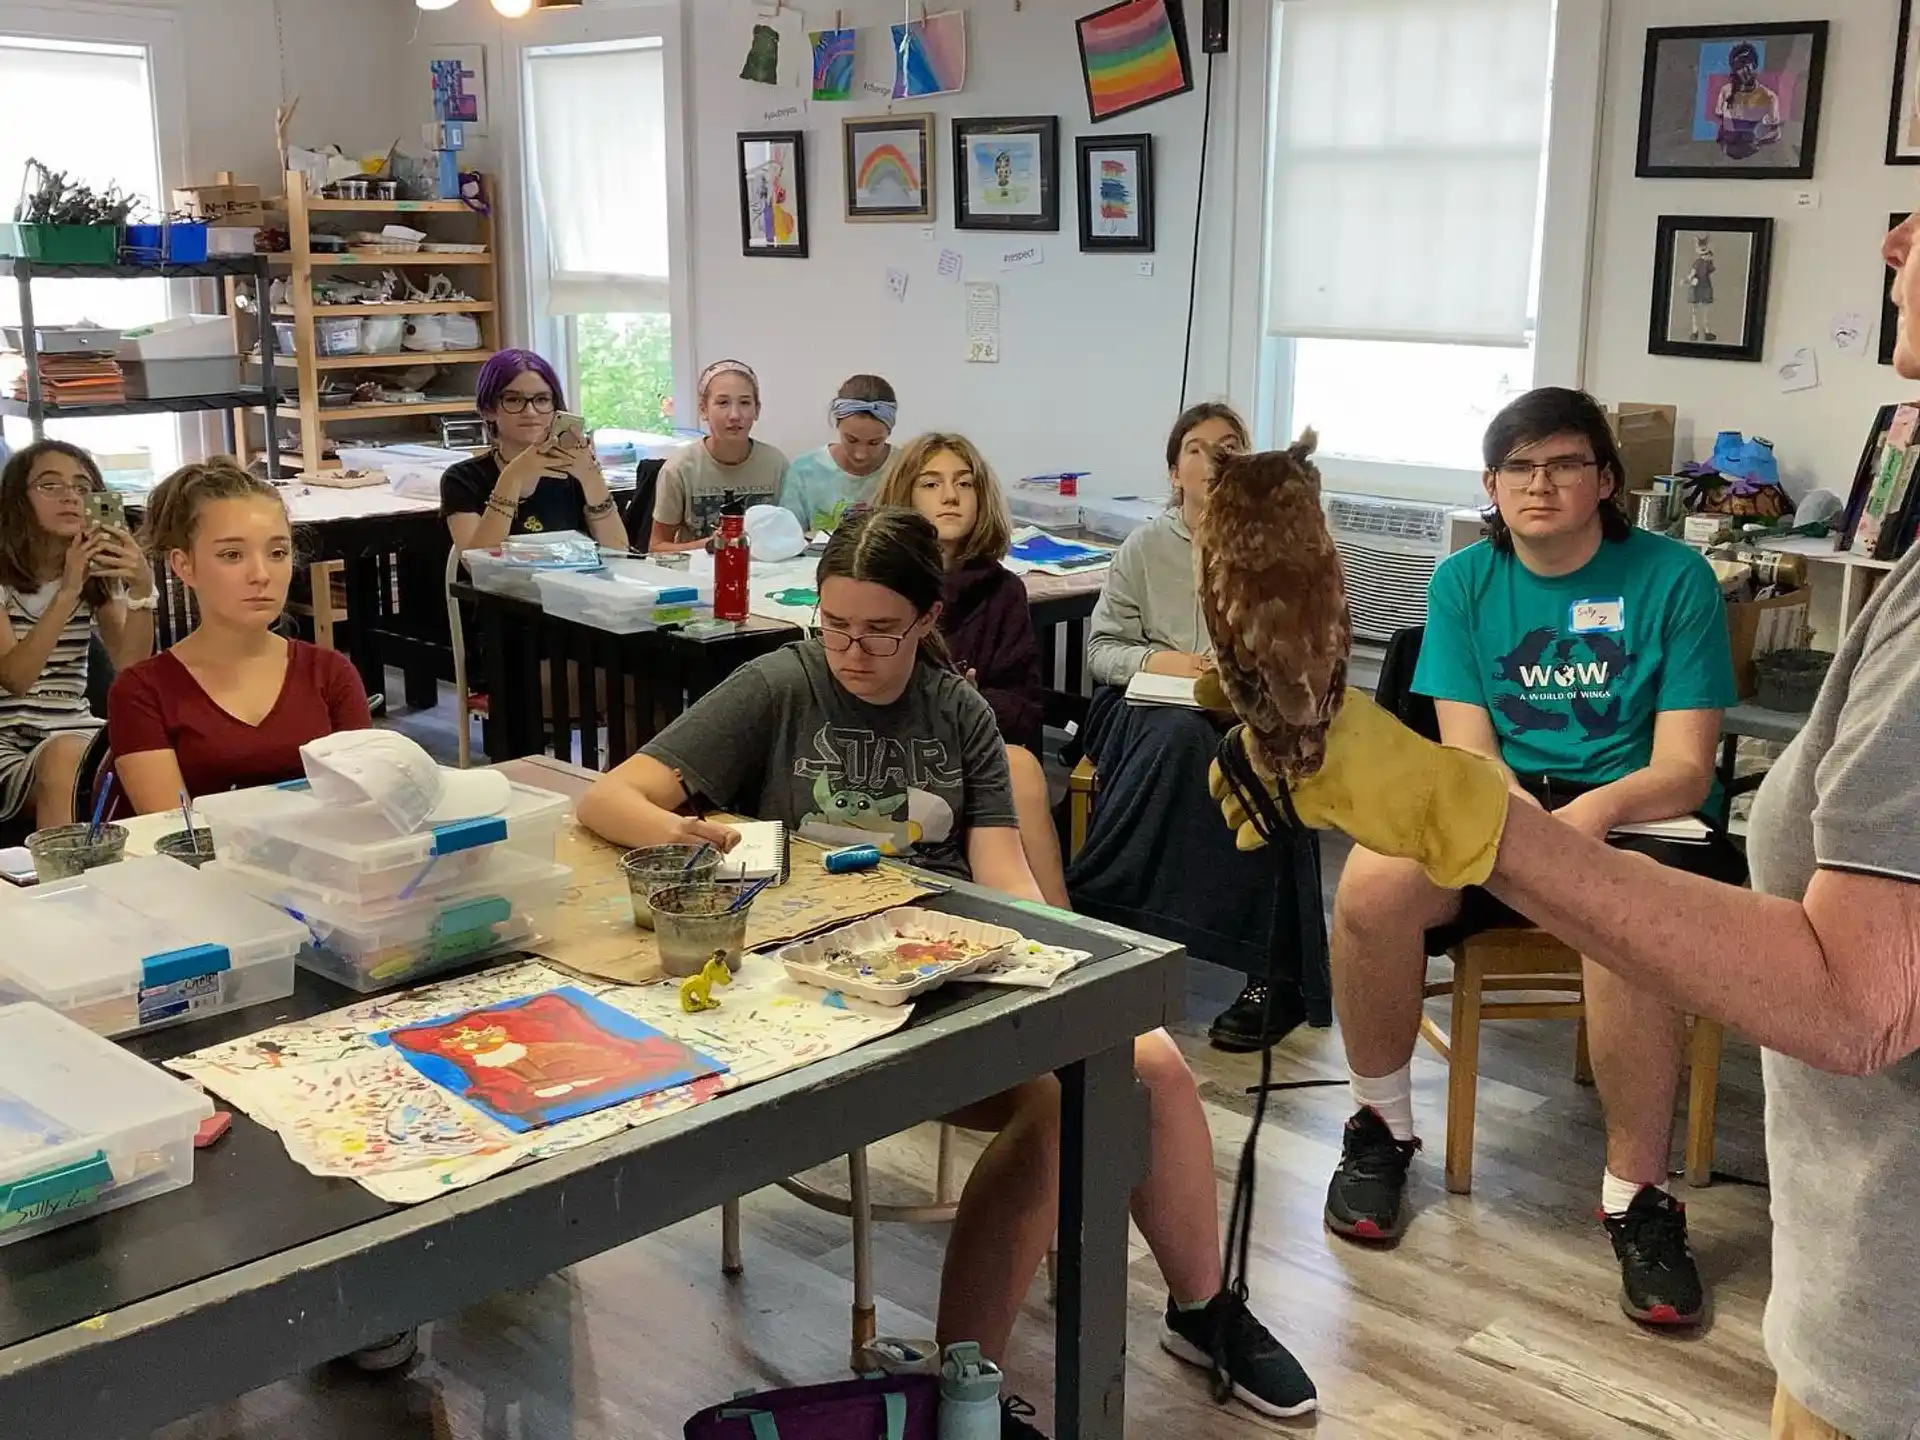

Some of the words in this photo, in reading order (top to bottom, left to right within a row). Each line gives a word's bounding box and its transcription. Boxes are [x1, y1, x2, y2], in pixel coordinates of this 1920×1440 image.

[1003, 248, 1035, 263] #respect
[1519, 661, 1609, 688] WOW
[1519, 693, 1527, 701] A
[1528, 692, 1564, 701] WORLD
[1566, 691, 1577, 700] OF
[1580, 689, 1612, 700] WINGS
[794, 720, 963, 790] STAR
[17, 1198, 61, 1224] Sully
